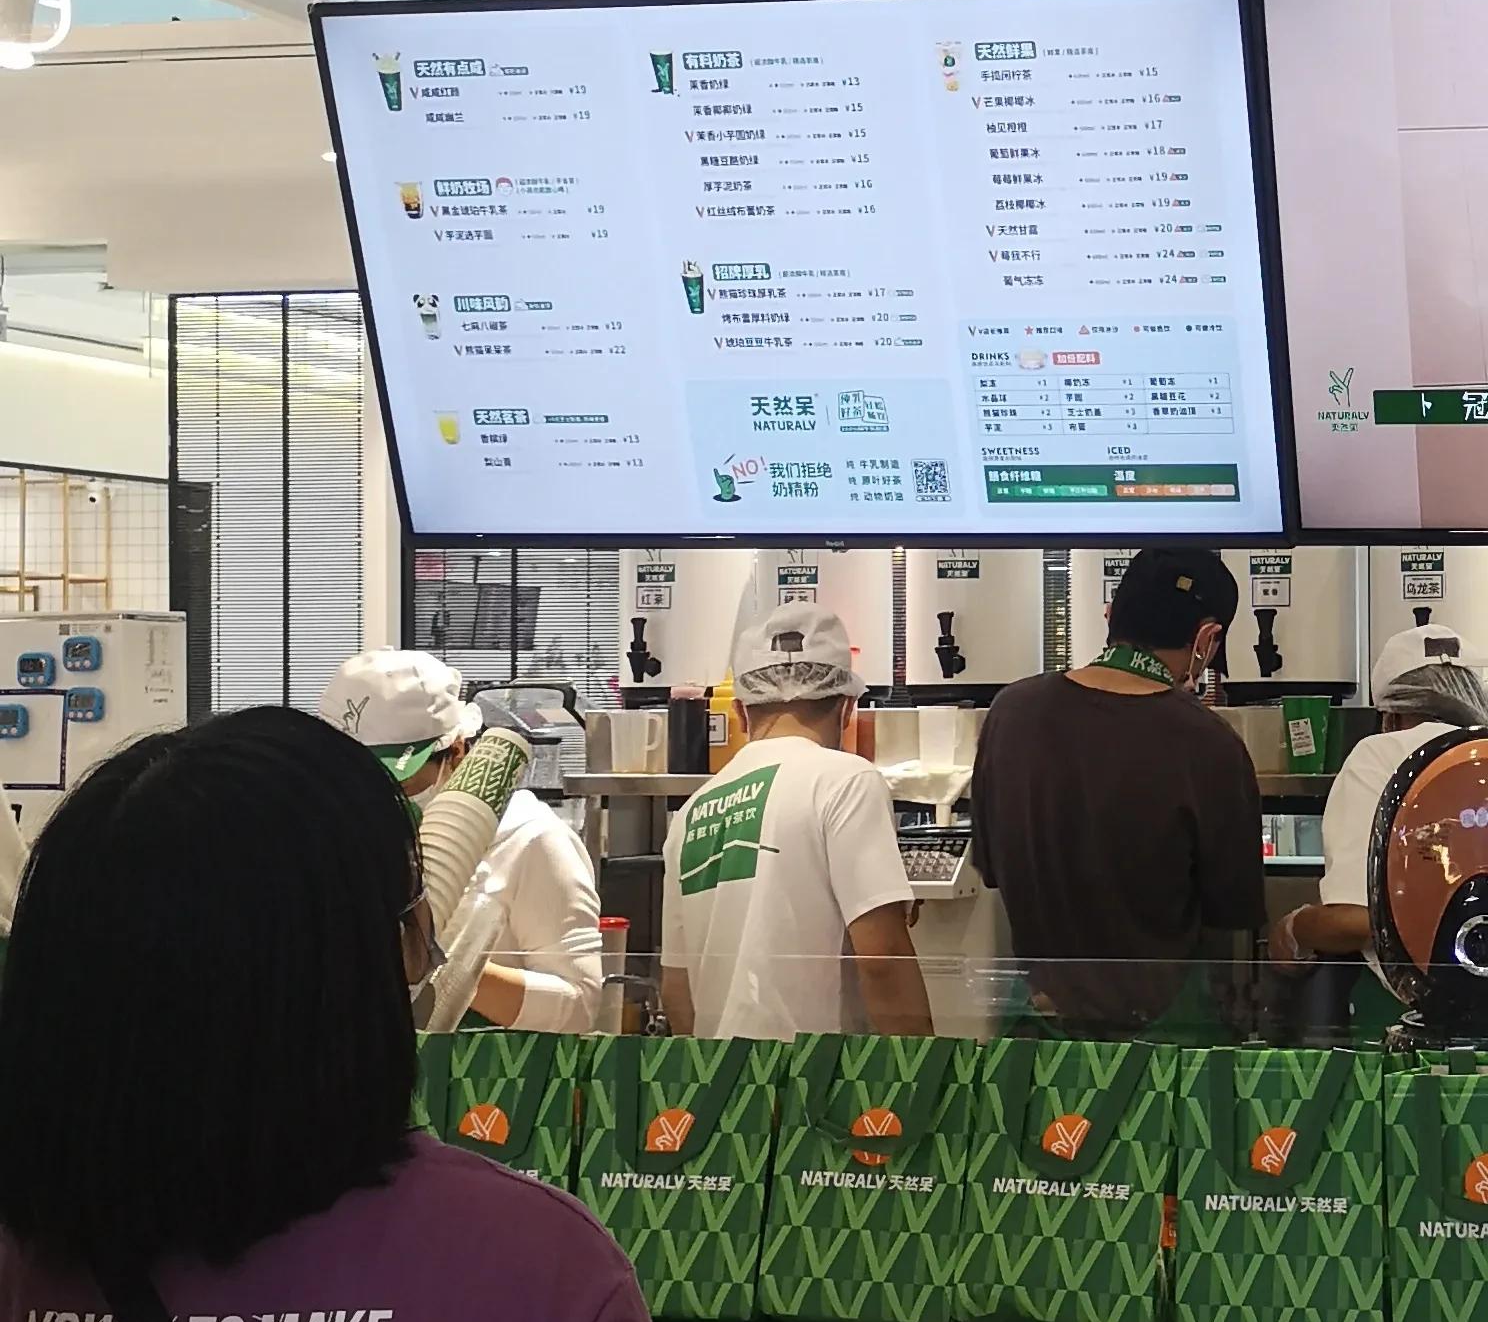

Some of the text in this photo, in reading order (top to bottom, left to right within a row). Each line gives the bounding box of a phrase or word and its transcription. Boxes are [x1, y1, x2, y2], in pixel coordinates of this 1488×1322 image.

[978, 42, 1035, 60] 天然鲜果
[685, 52, 741, 69] 有料奶茶
[436, 180, 491, 196] 鲜奶牧场
[714, 264, 770, 280] 招牌厚乳
[971, 352, 1010, 361] DRINKS
[751, 395, 816, 416] 天然呆
[475, 410, 528, 424] 天然茗茶
[1317, 410, 1369, 422] NATURALV
[753, 420, 817, 431] NATURALV
[982, 447, 1040, 455] SWEETNESS
[1107, 446, 1131, 455] ICED
[769, 462, 832, 479] 我们拒绝
[860, 459, 900, 470] 牛乳制造
[862, 475, 902, 486] 原叶好茶
[772, 481, 819, 497] 奶精粉
[863, 491, 904, 502] 动物奶油
[1407, 582, 1441, 594] 乌龙茶
[640, 593, 665, 605] 红茶
[601, 1172, 732, 1192] NATURALV 天然呆
[801, 1170, 935, 1193] NATURALV 天然呆
[993, 1178, 1131, 1201] NATURALV 天然呆
[1205, 1194, 1348, 1214] NATURALV 天然呆
